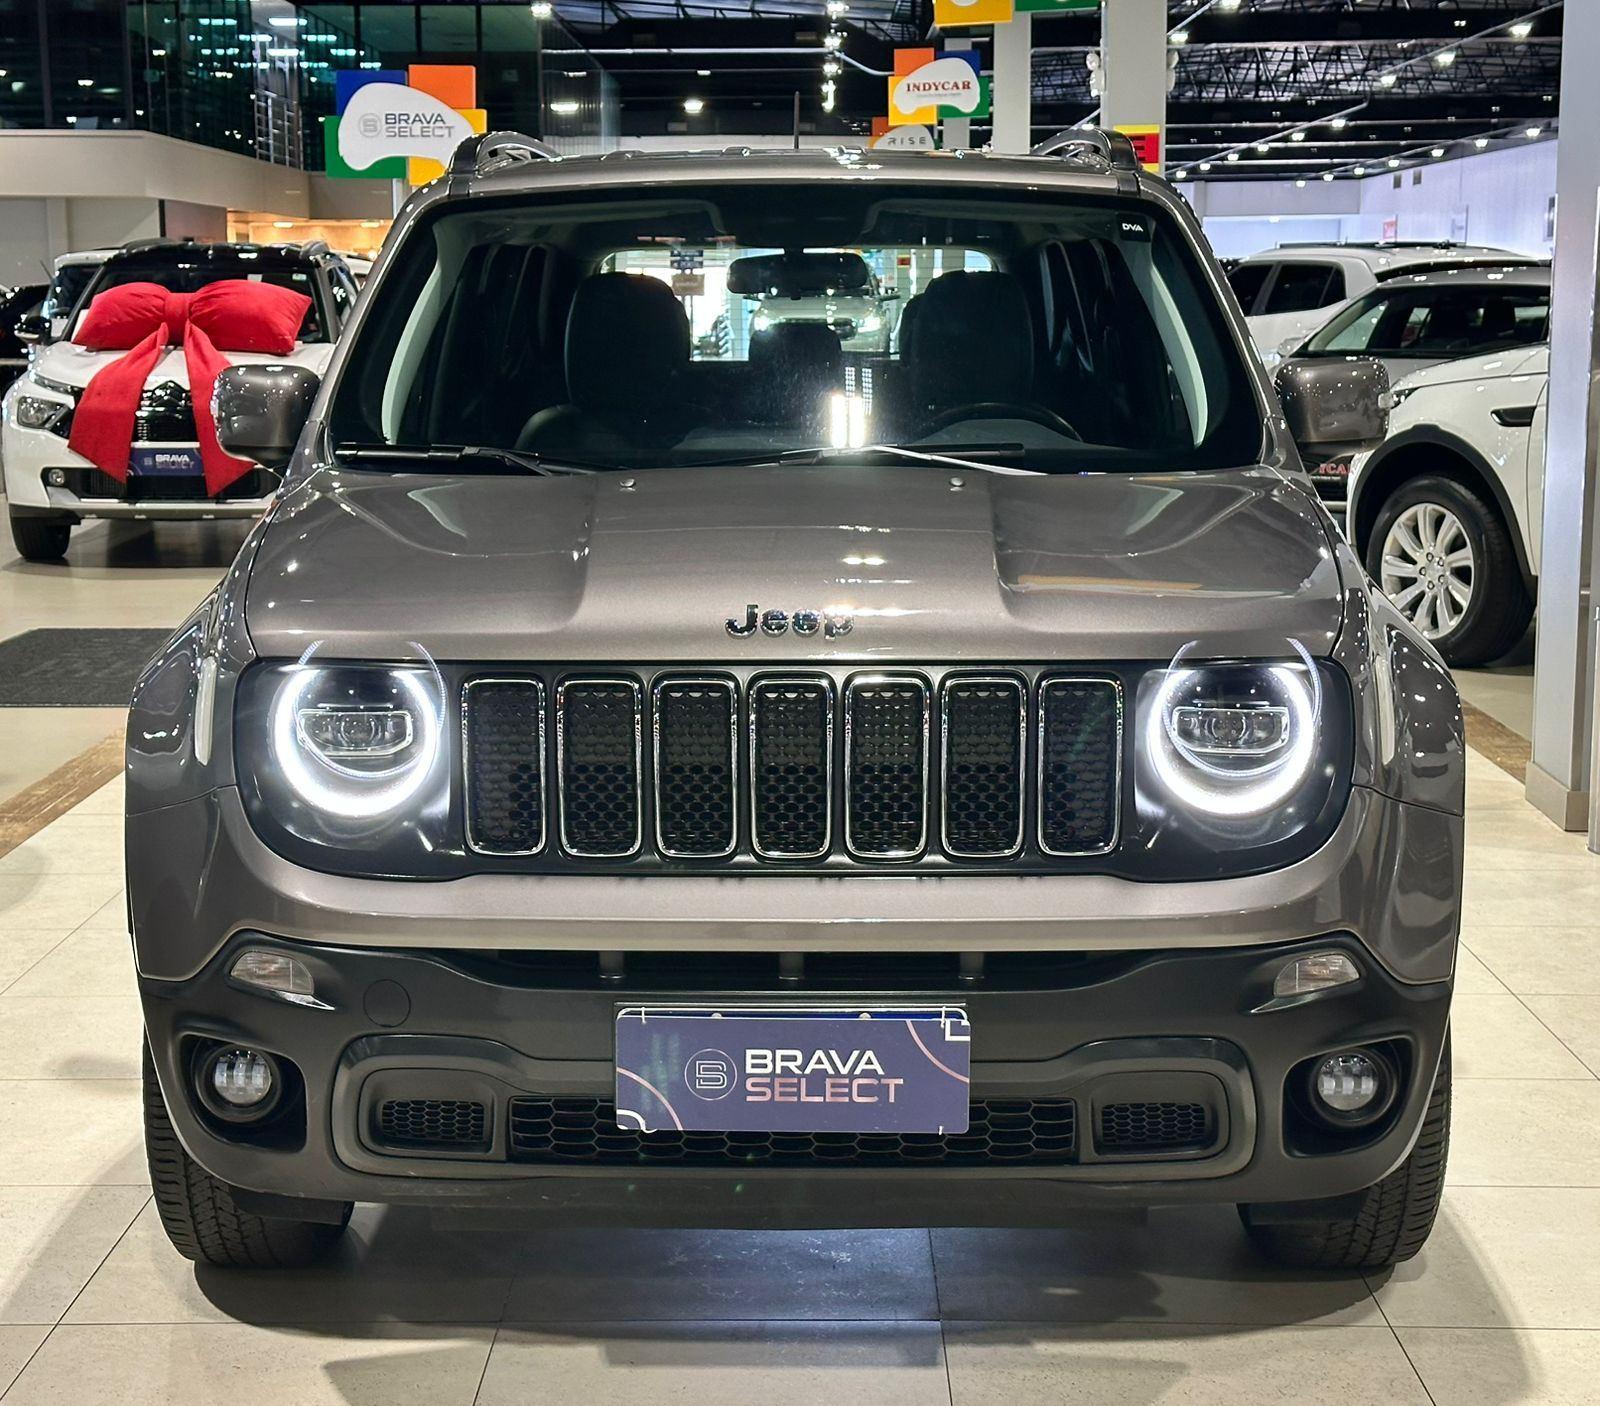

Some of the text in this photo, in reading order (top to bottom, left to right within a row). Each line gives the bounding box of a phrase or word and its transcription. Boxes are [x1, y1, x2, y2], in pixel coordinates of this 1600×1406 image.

[906, 80, 972, 92] INDYCAR
[385, 113, 446, 125] BRAVA
[386, 126, 455, 138] SELECT
[887, 136, 926, 146] RISE
[1121, 222, 1144, 232] DVA
[155, 454, 190, 463] BRAVA
[725, 603, 855, 641] Jeep
[745, 1049, 885, 1075] BRAVA
[745, 1077, 904, 1103] SELECT
